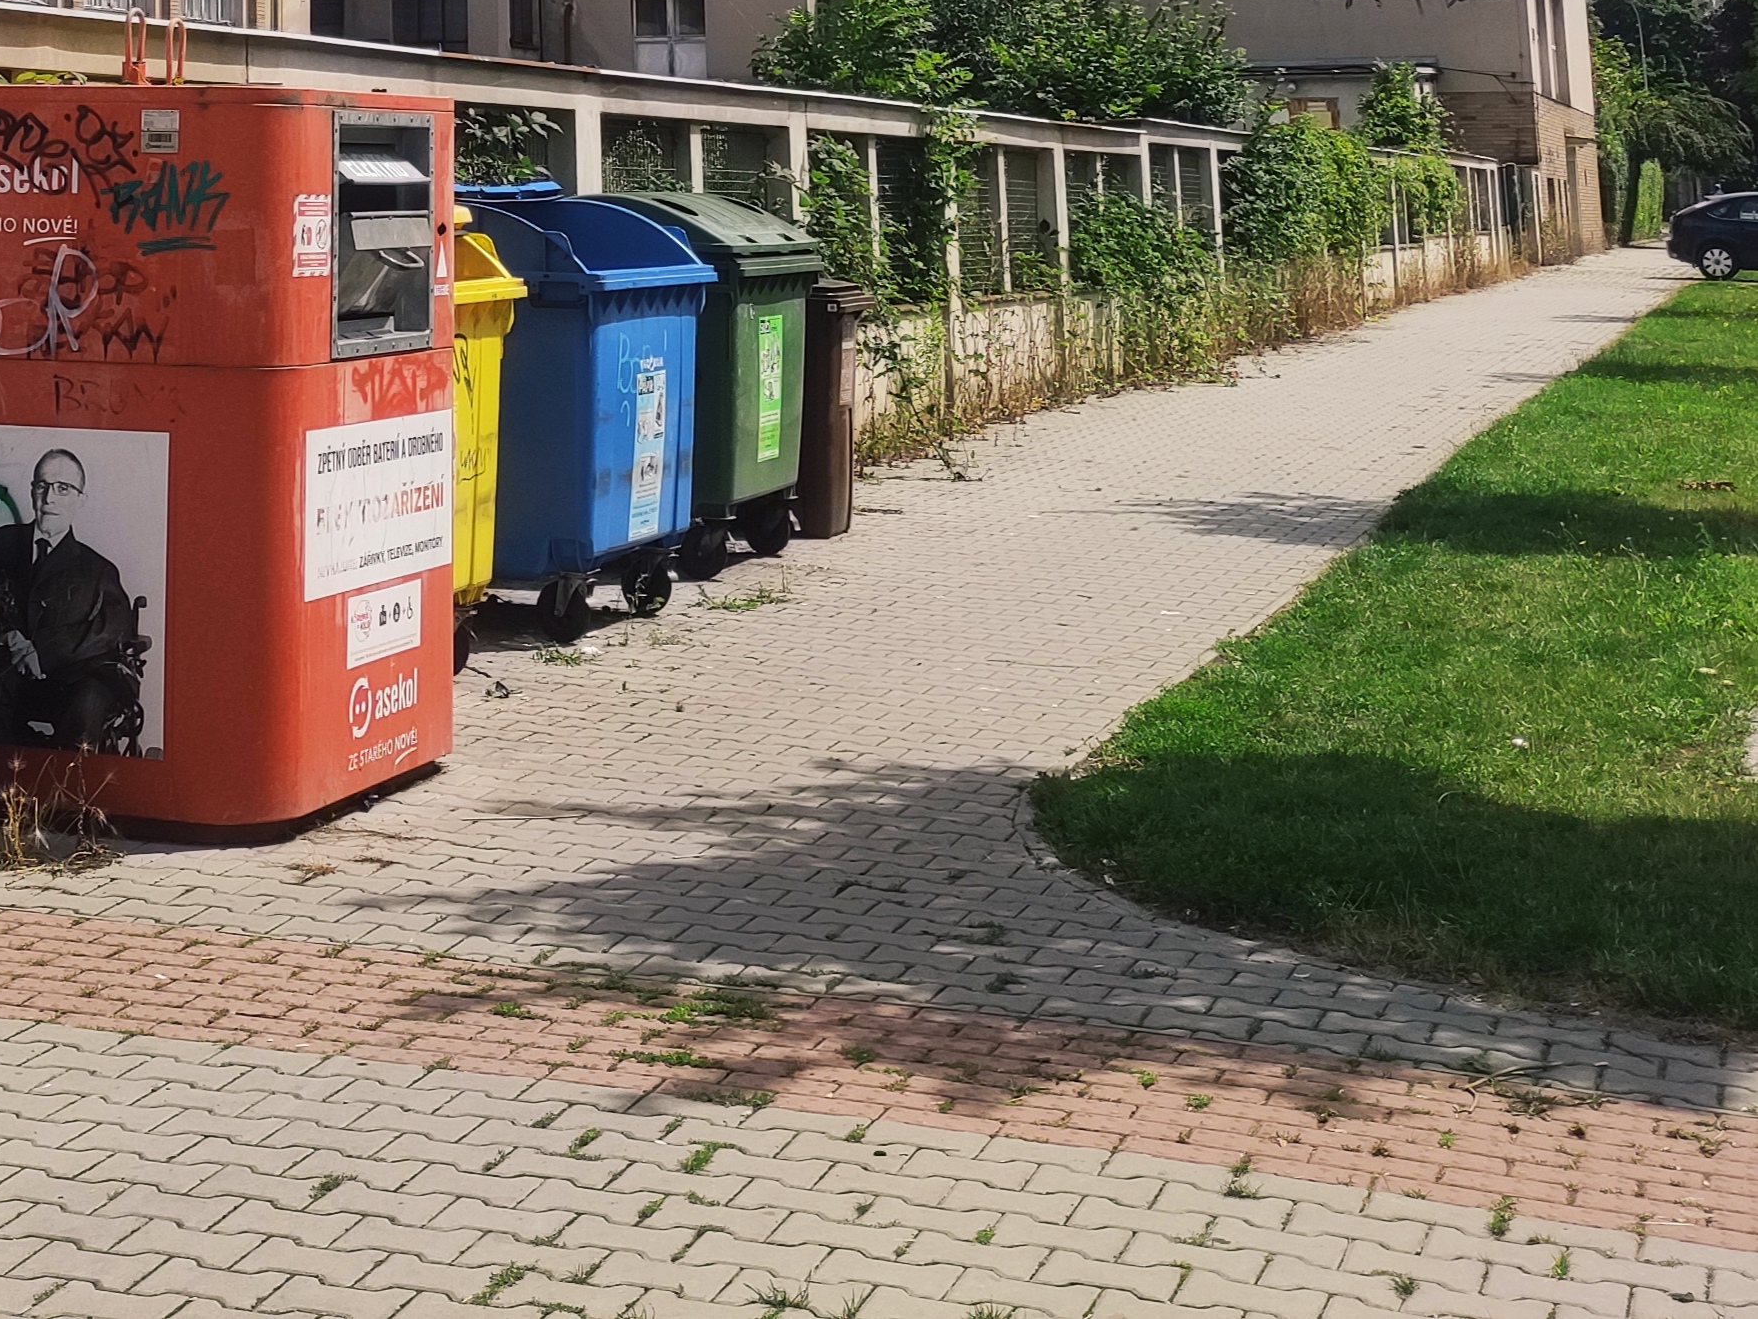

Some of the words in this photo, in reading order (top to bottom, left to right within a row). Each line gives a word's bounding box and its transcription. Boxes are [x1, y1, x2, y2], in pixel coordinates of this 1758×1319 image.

[23, 215, 78, 234] NOVÉ!
[317, 443, 346, 475] ZPĚTNÝ
[348, 439, 372, 469] ODBĚR
[373, 433, 400, 464] BATERIÍ
[401, 439, 407, 459] A
[408, 427, 444, 457] DROBNÉHO
[375, 667, 418, 720] asekol
[348, 753, 359, 771] ZE
[360, 740, 393, 767] STARÉHO
[394, 726, 418, 751] NOVÉ!
